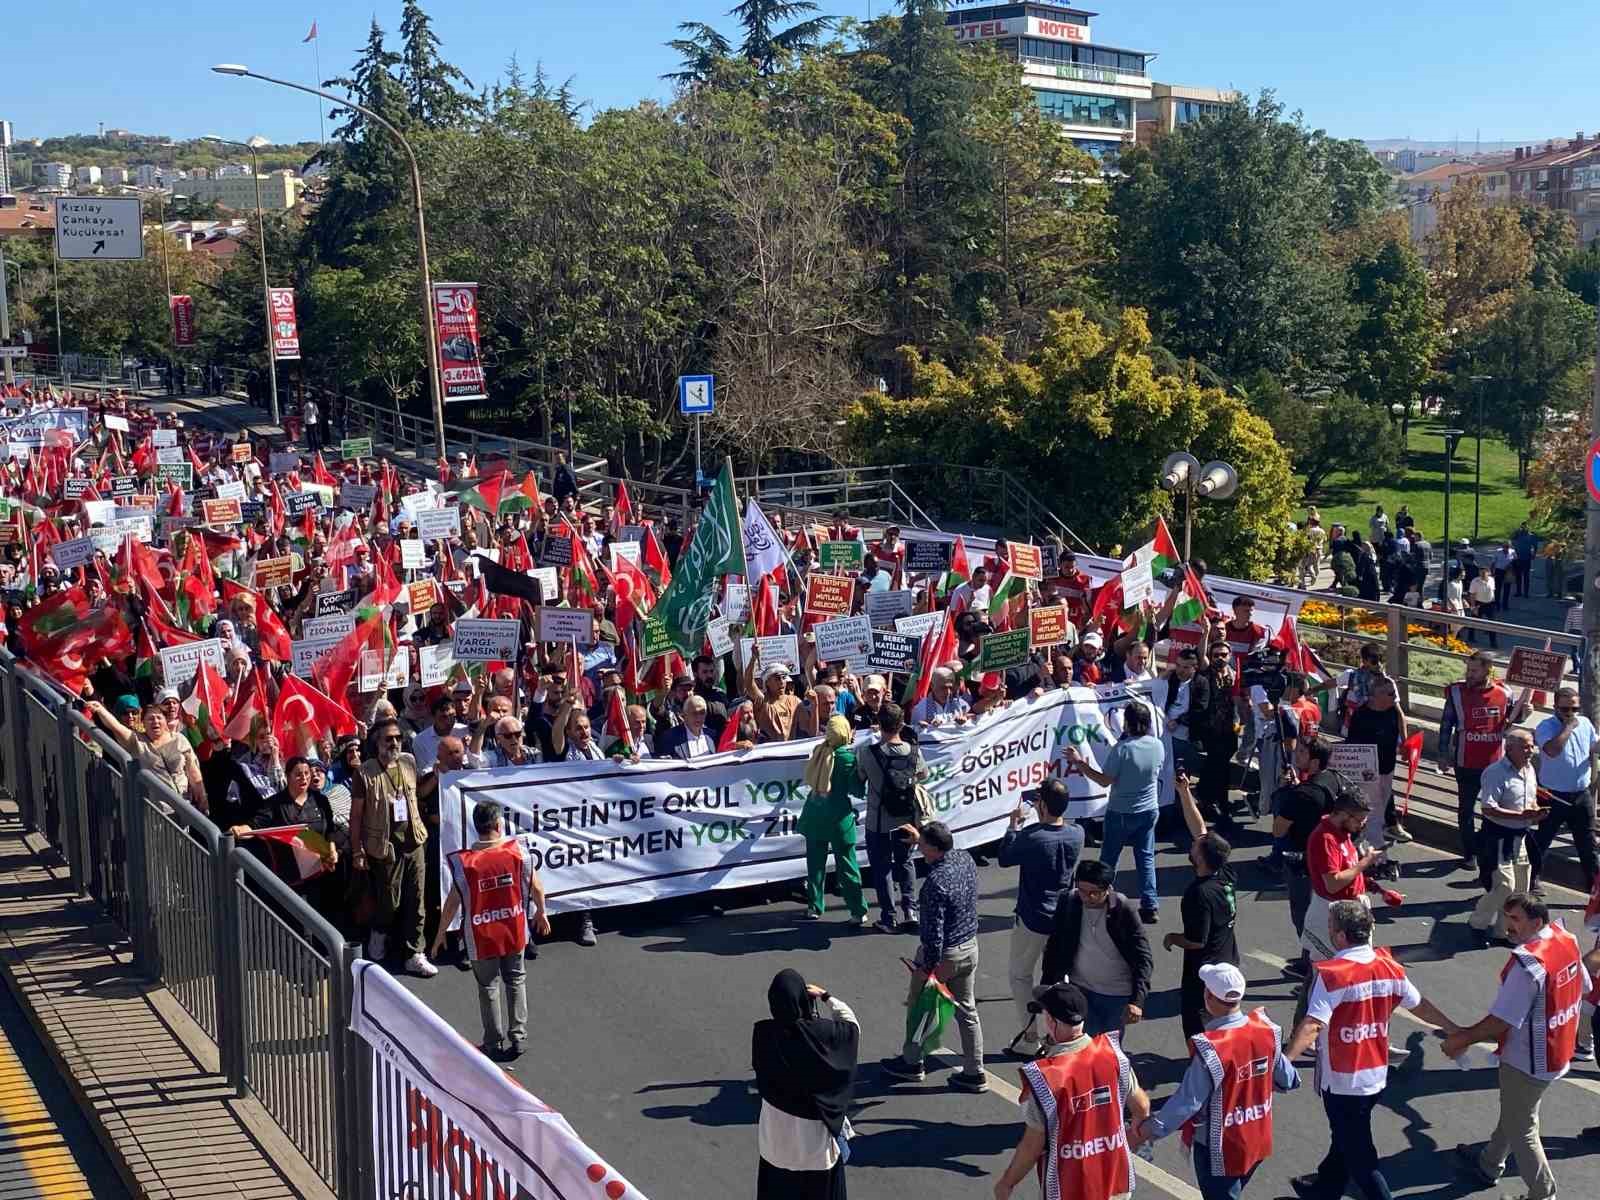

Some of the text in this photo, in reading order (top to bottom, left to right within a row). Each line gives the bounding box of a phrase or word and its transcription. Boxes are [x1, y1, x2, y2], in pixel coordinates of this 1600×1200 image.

[1038, 20, 1083, 40] HOTEL
[62, 203, 102, 214] Kızılay
[271, 292, 293, 306] 50
[437, 289, 474, 313] 50
[875, 640, 912, 652] KATİLLERİ
[883, 635, 906, 643] BEBEK
[881, 651, 905, 659] HESAP
[503, 798, 656, 836] İLİSTİN'DE
[663, 786, 740, 815] OKUL
[961, 724, 1048, 774] ÖĞRENCİ
[528, 827, 683, 871] ÖĞRETMEN
[690, 818, 755, 847] YOK.
[962, 775, 1002, 805] SEN
